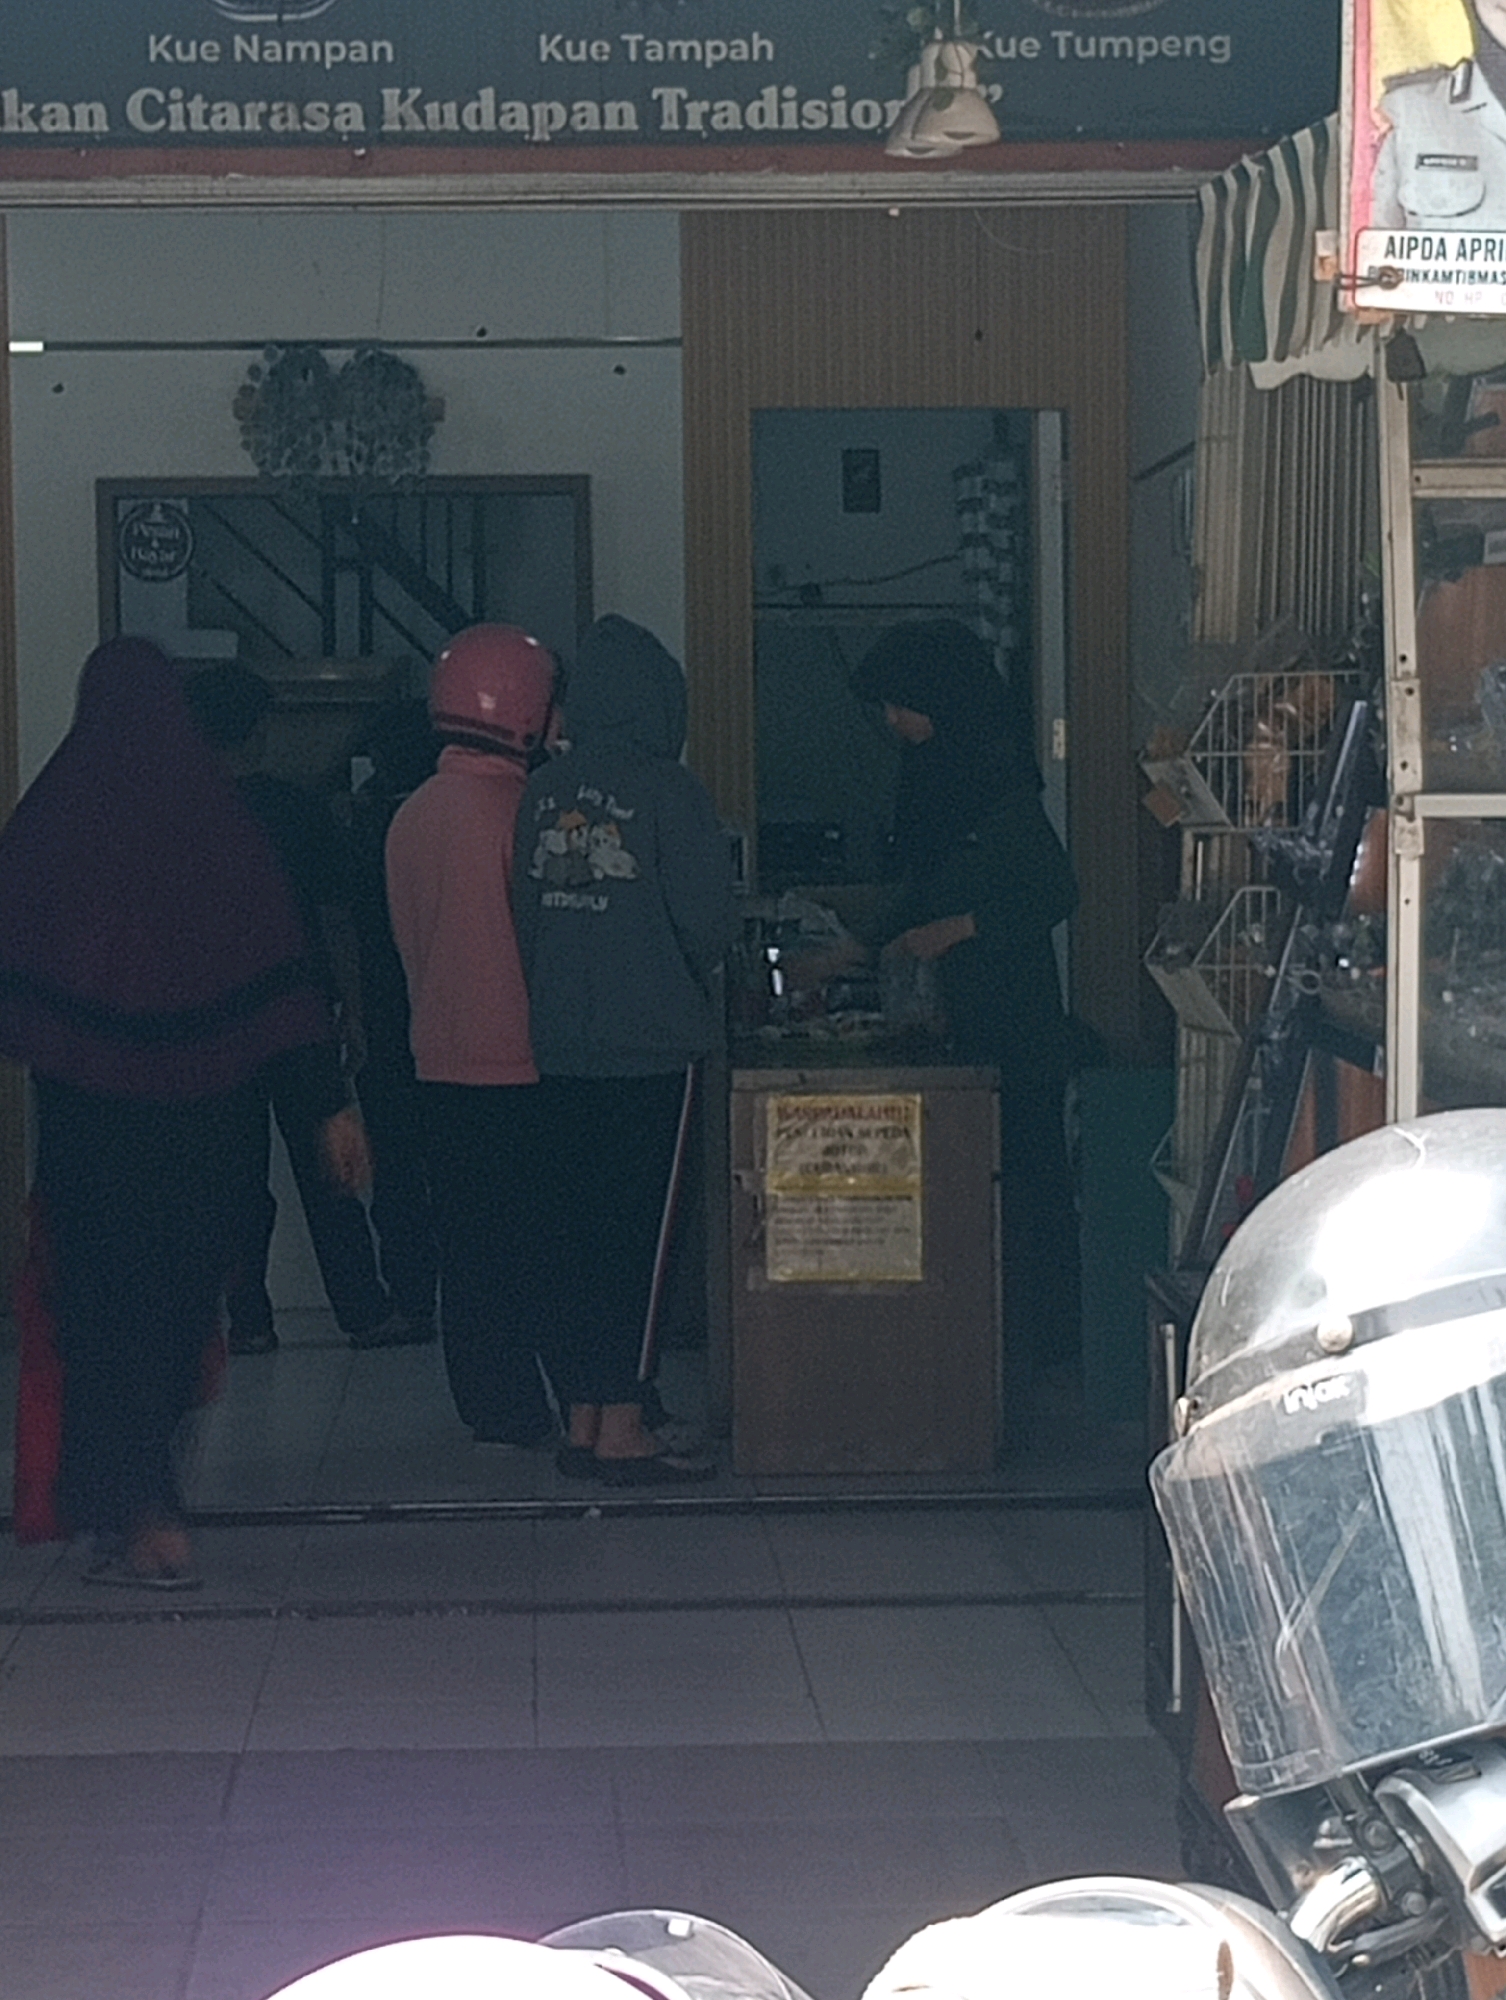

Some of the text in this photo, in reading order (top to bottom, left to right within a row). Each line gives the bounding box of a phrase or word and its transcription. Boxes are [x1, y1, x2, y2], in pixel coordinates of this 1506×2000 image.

[149, 34, 394, 70] Kue Nampan
[539, 32, 774, 68] Kue Tampah
[1050, 30, 1231, 64] Tumpeng
[0, 88, 110, 133] kan
[125, 87, 365, 133] Citarasa
[381, 87, 639, 141] Kudapan
[1384, 235, 1504, 262] AIPDA APRI
